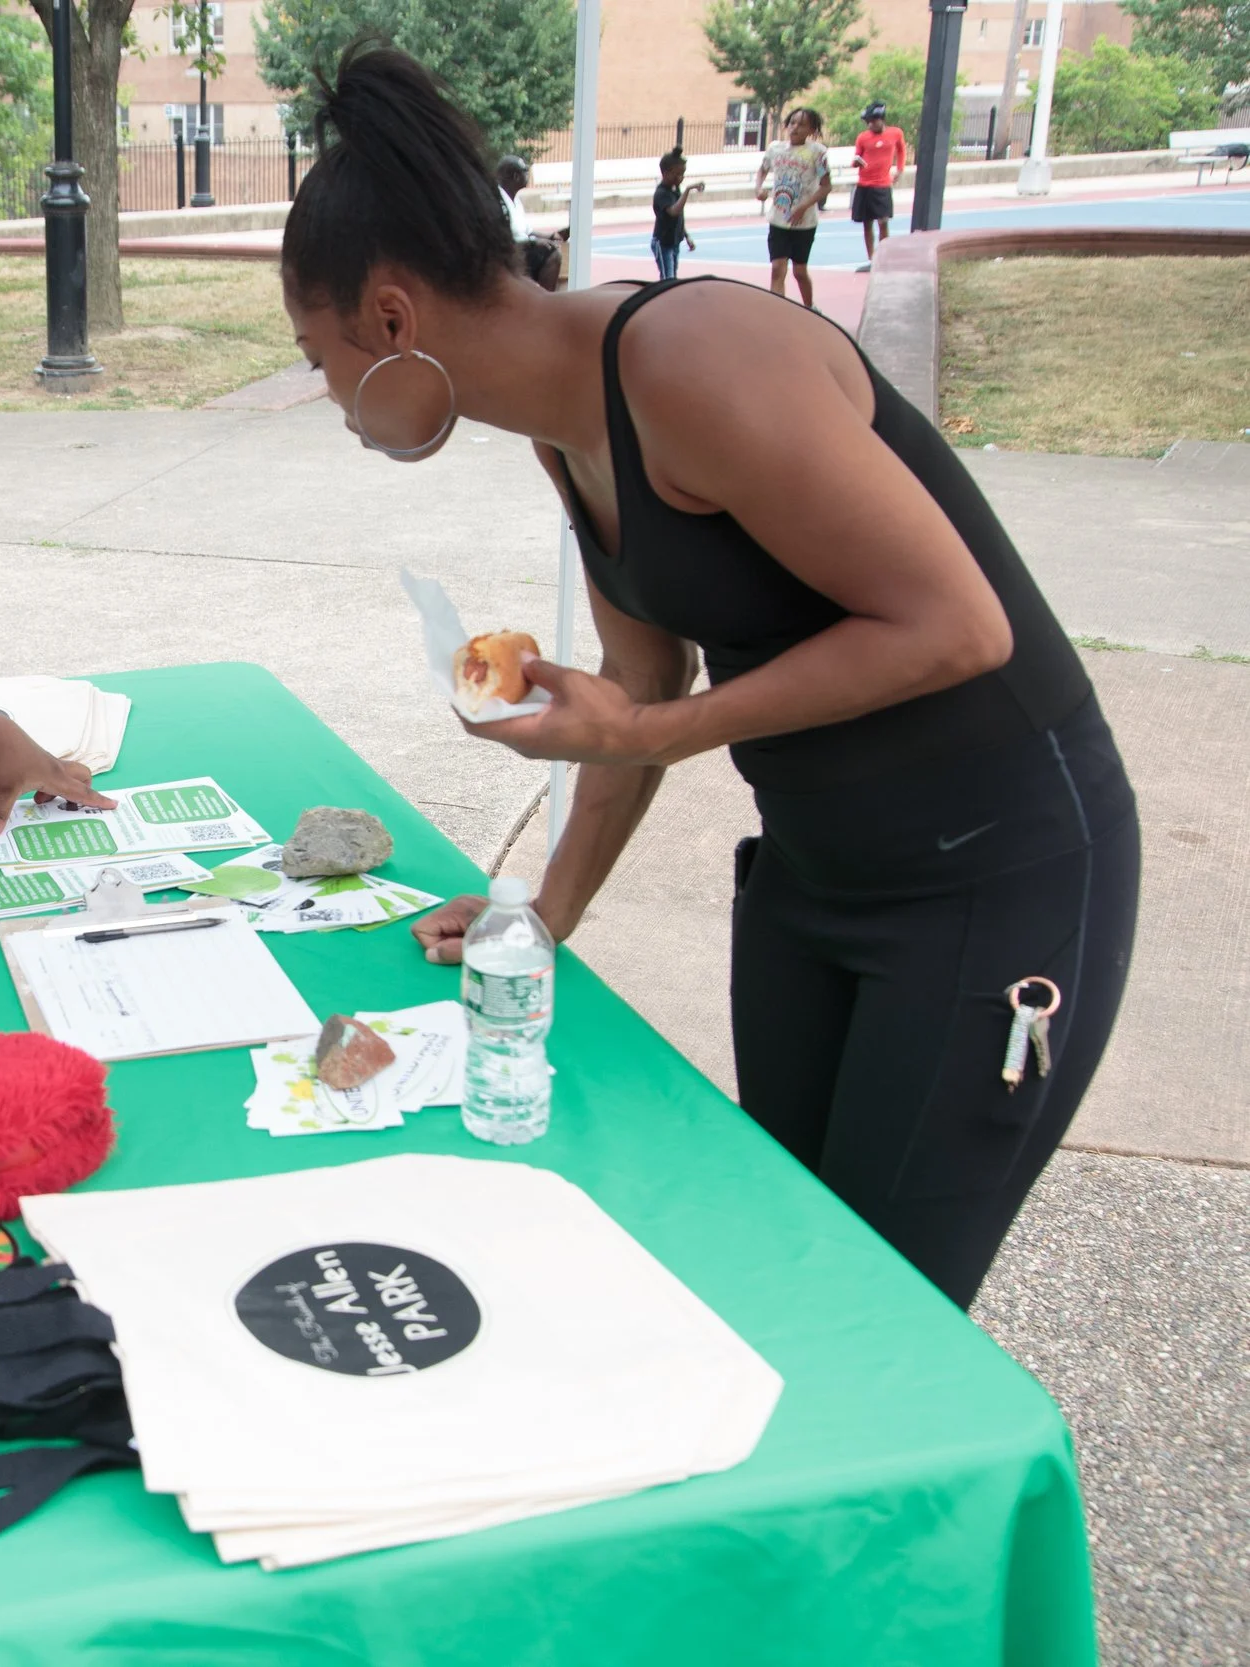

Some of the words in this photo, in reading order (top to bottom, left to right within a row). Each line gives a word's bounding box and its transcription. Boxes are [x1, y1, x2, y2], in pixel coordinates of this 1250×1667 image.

[311, 1249, 368, 1315] Allen
[367, 1263, 449, 1341] PARK
[354, 1321, 418, 1377] Jesse
